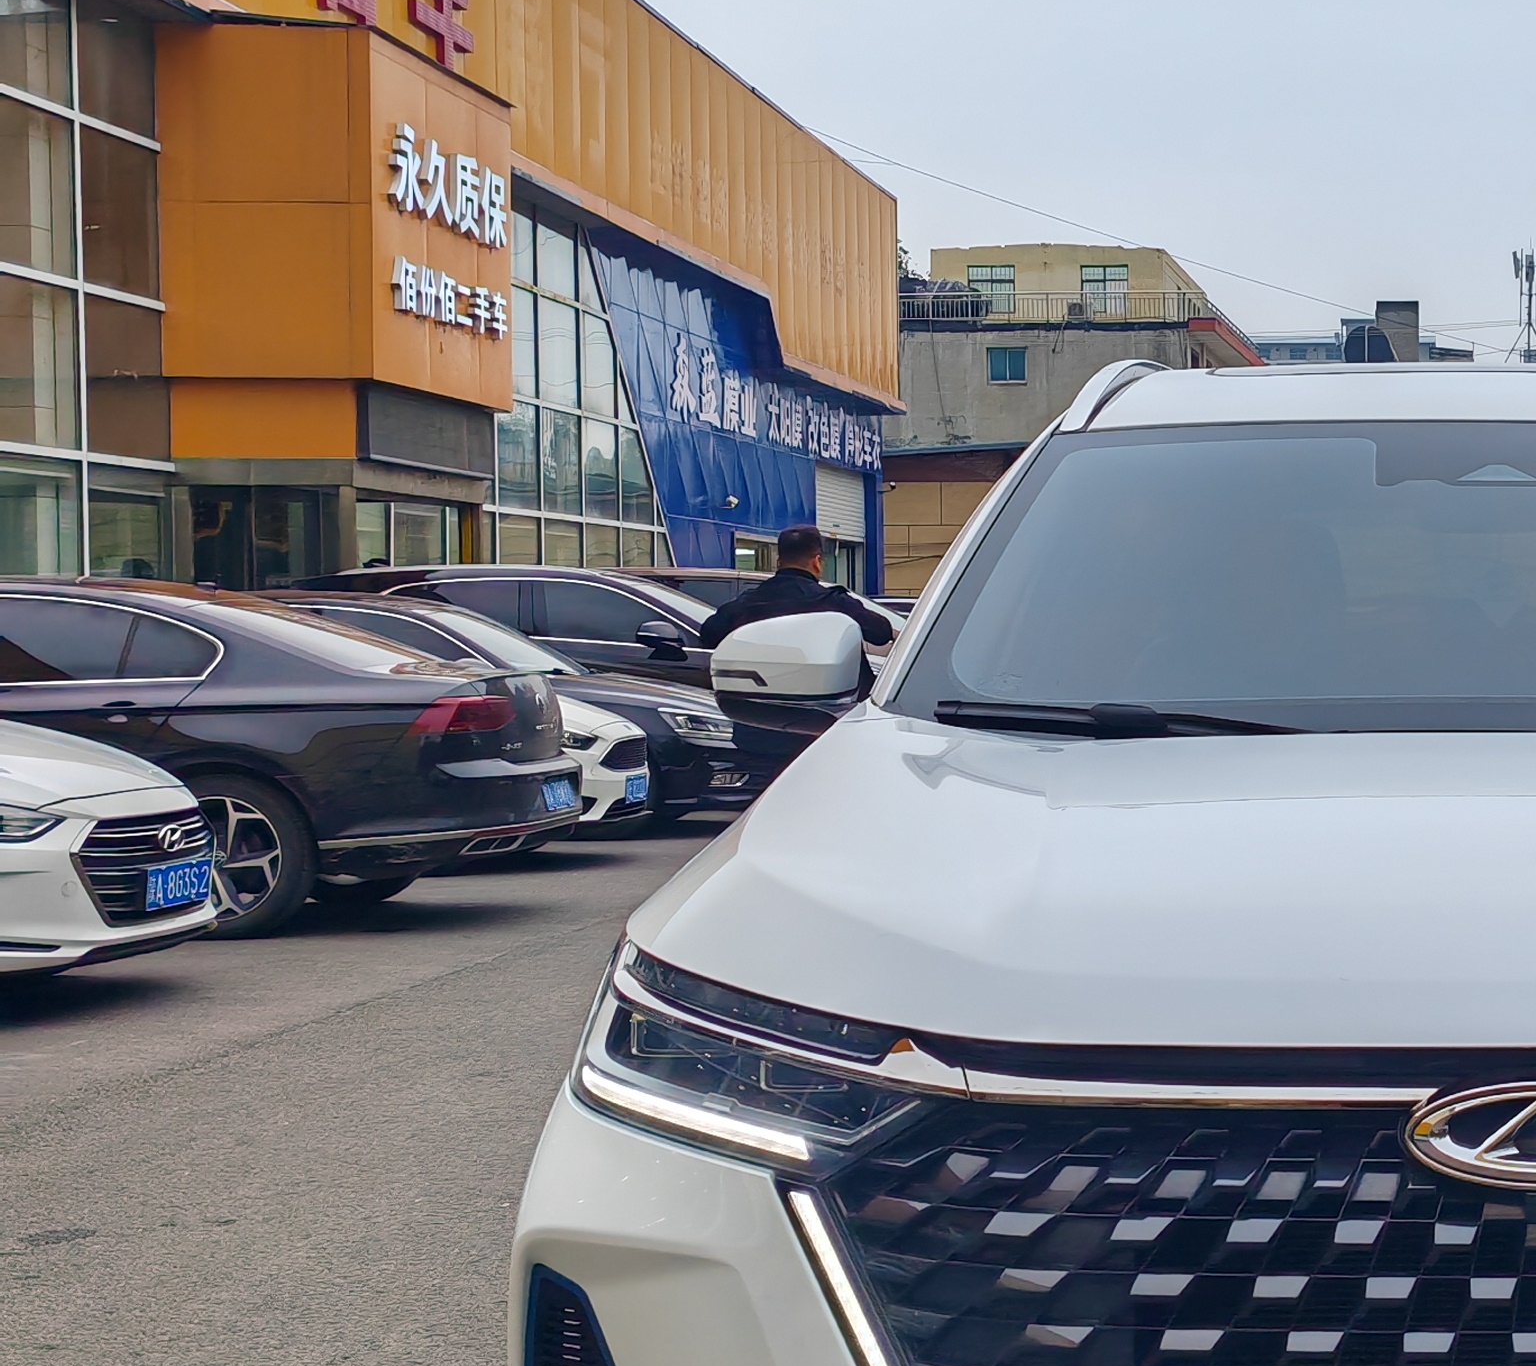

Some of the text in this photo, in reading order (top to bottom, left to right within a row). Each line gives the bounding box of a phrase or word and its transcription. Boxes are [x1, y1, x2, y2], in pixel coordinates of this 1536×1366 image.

[388, 122, 508, 249] 永久质保
[393, 255, 508, 341] 佰份佰二手车
